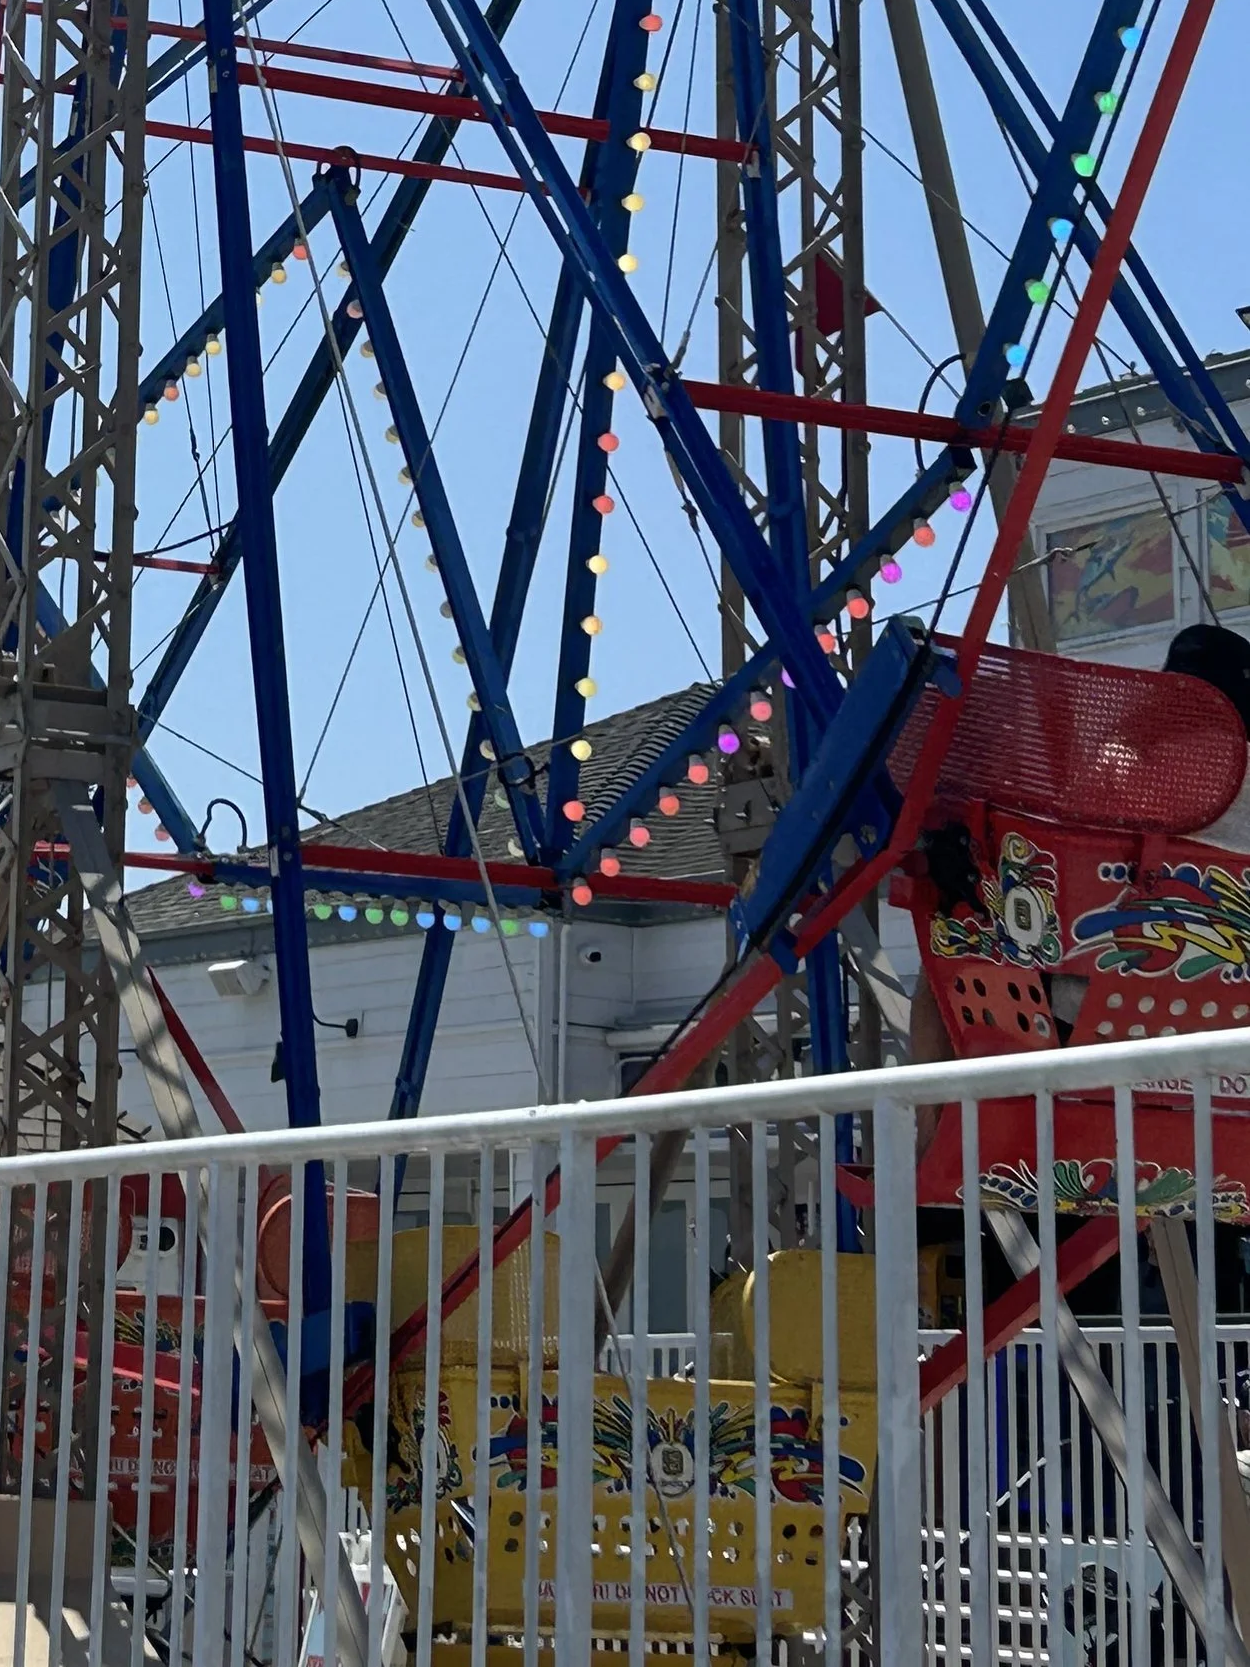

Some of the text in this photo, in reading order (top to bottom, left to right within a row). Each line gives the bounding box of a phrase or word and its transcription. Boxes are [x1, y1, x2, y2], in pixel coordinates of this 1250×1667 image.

[1219, 1075, 1247, 1094] DO
[152, 1459, 176, 1474] NO
[646, 1585, 680, 1604] NOT
[707, 1587, 736, 1605] CK
